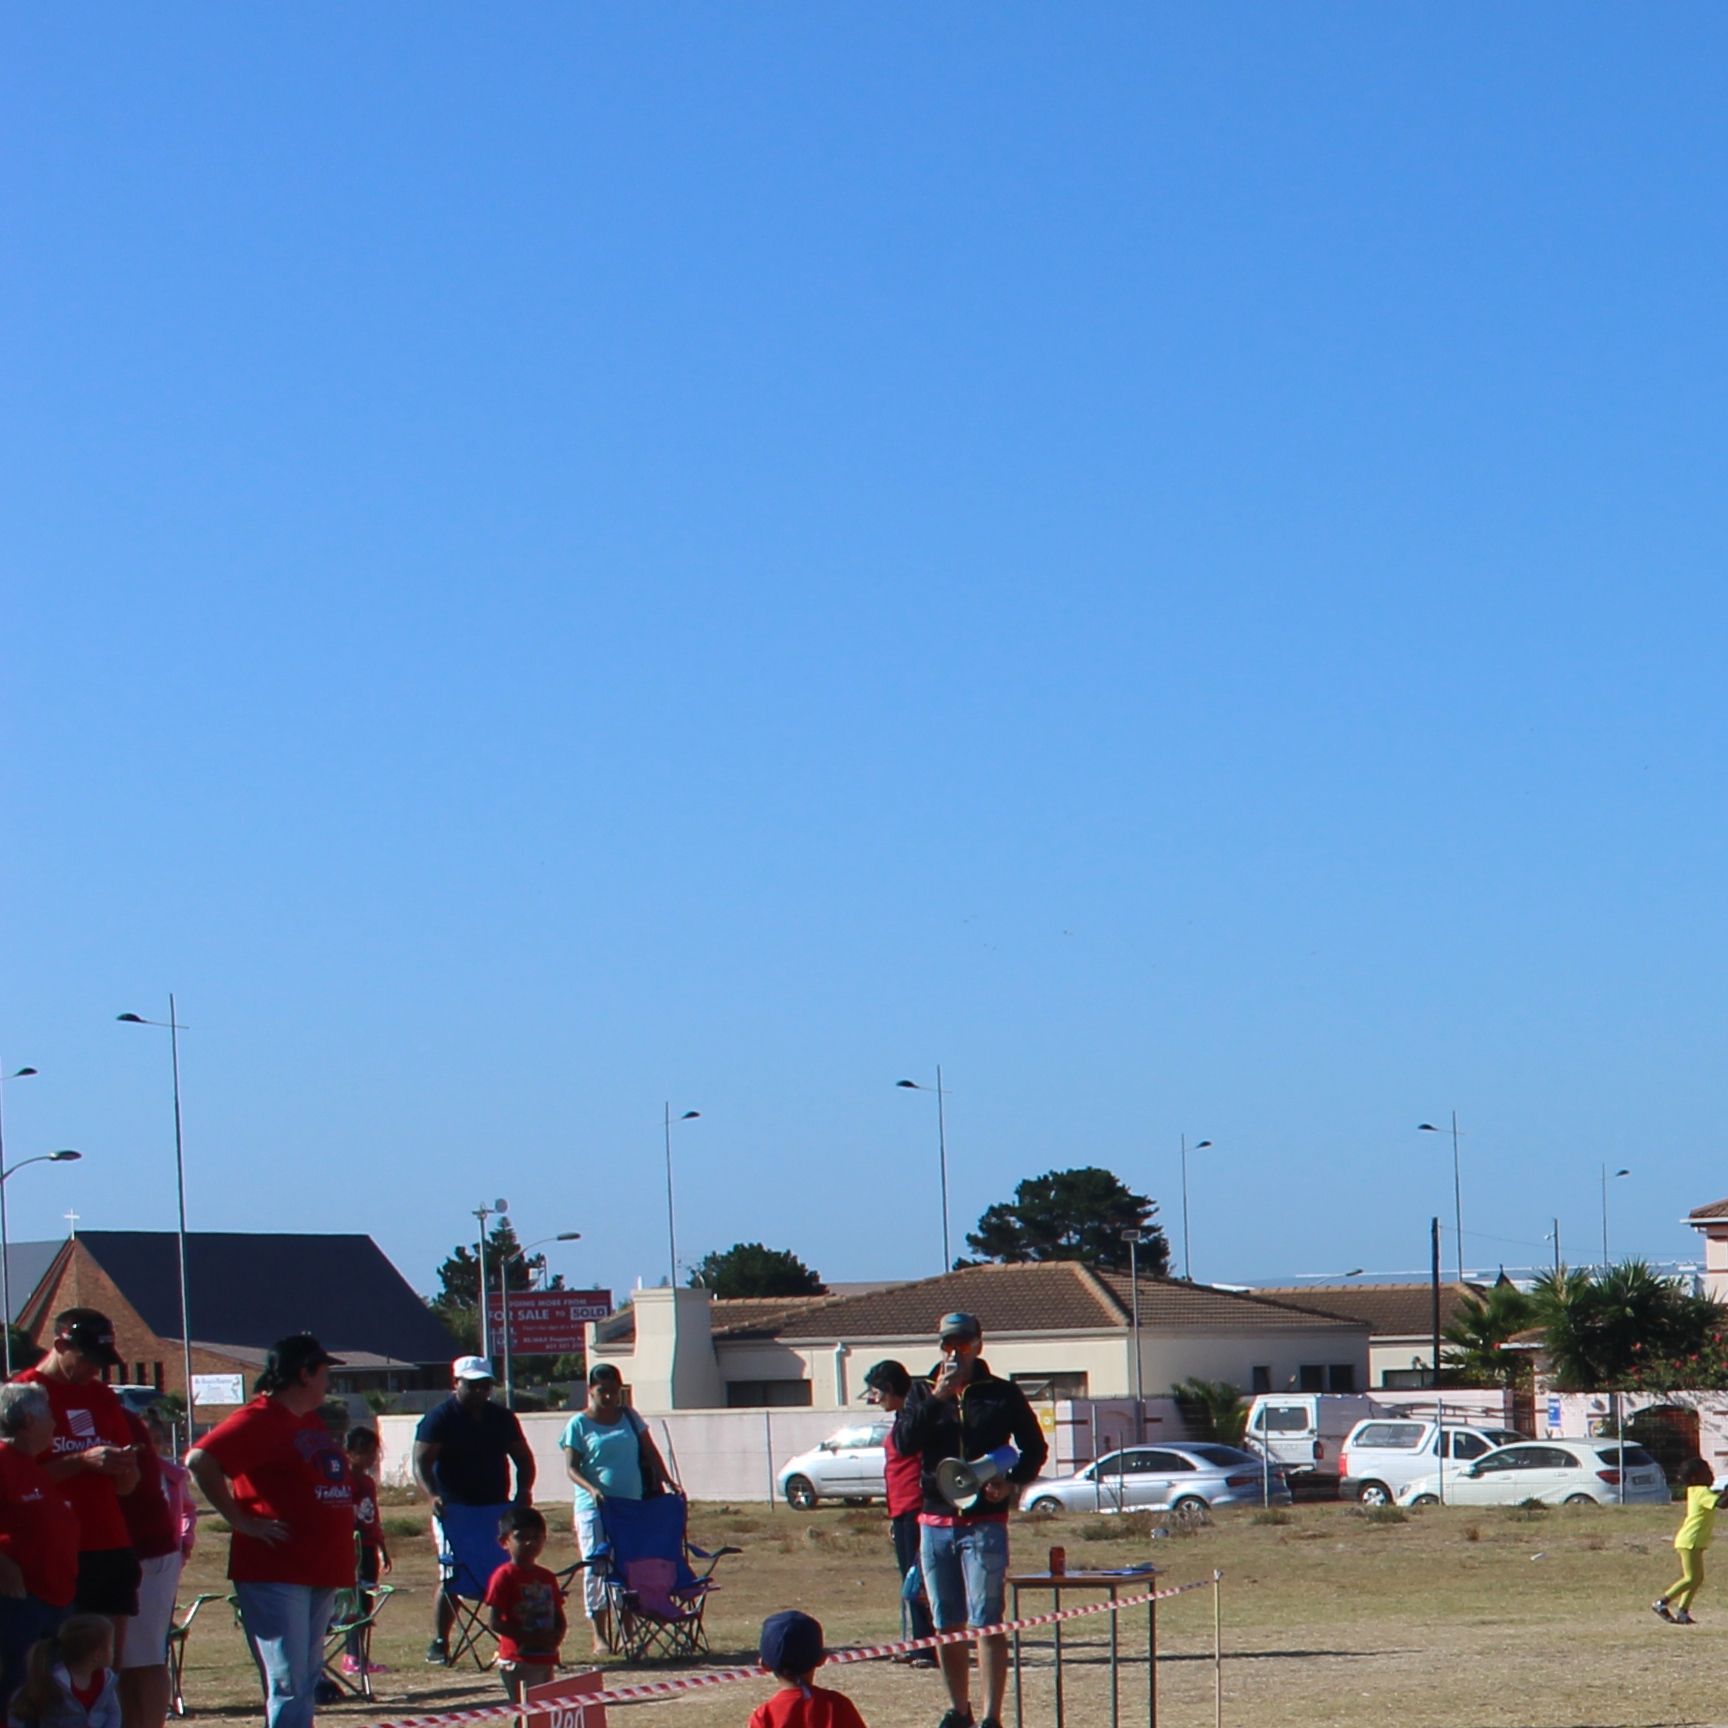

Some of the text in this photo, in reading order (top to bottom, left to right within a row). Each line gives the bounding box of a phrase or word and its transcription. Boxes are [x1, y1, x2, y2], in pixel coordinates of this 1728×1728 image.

[538, 1299, 561, 1307] MORE
[563, 1298, 587, 1306] FROM
[518, 1309, 550, 1320] SALE
[572, 1307, 606, 1319] SOLD
[52, 1436, 112, 1453] SlowM
